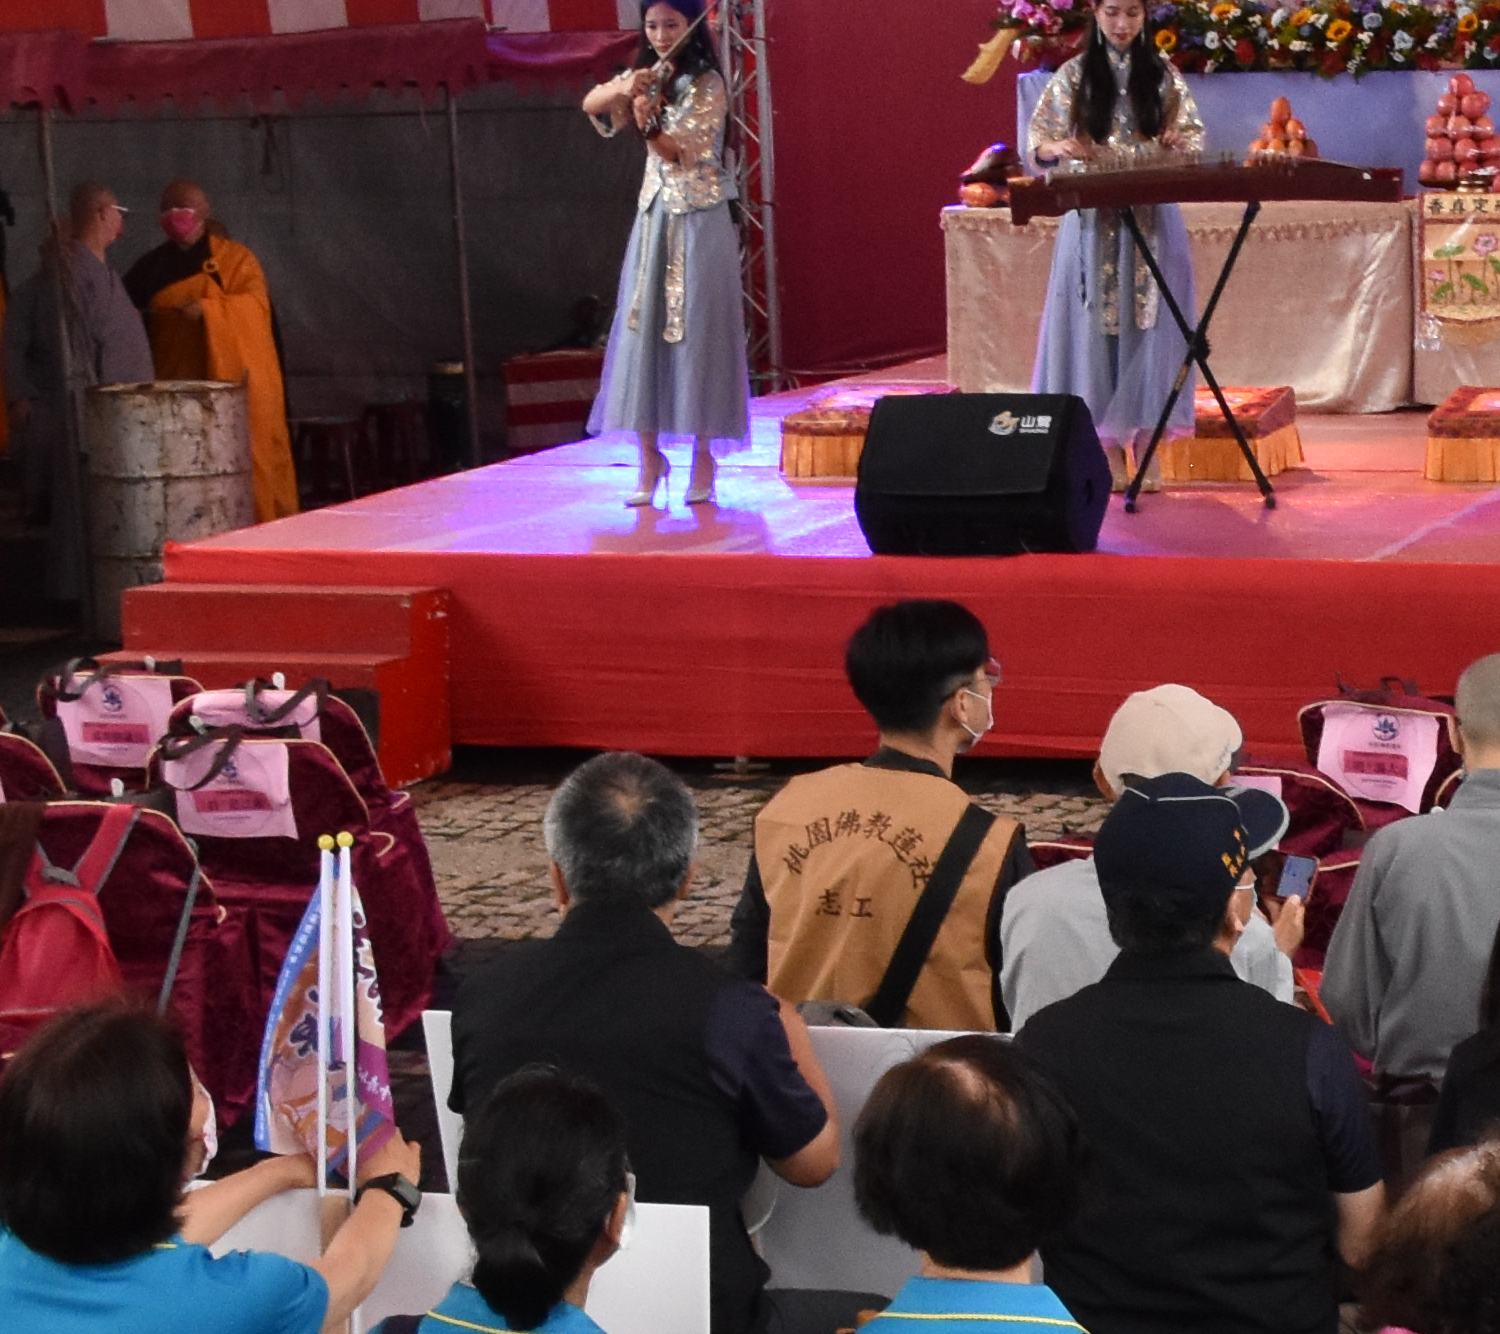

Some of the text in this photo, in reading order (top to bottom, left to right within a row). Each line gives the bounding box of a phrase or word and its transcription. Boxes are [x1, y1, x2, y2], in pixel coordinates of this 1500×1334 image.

[783, 808, 937, 890] 桃園佛教蓮社
[815, 888, 873, 918] 志工
